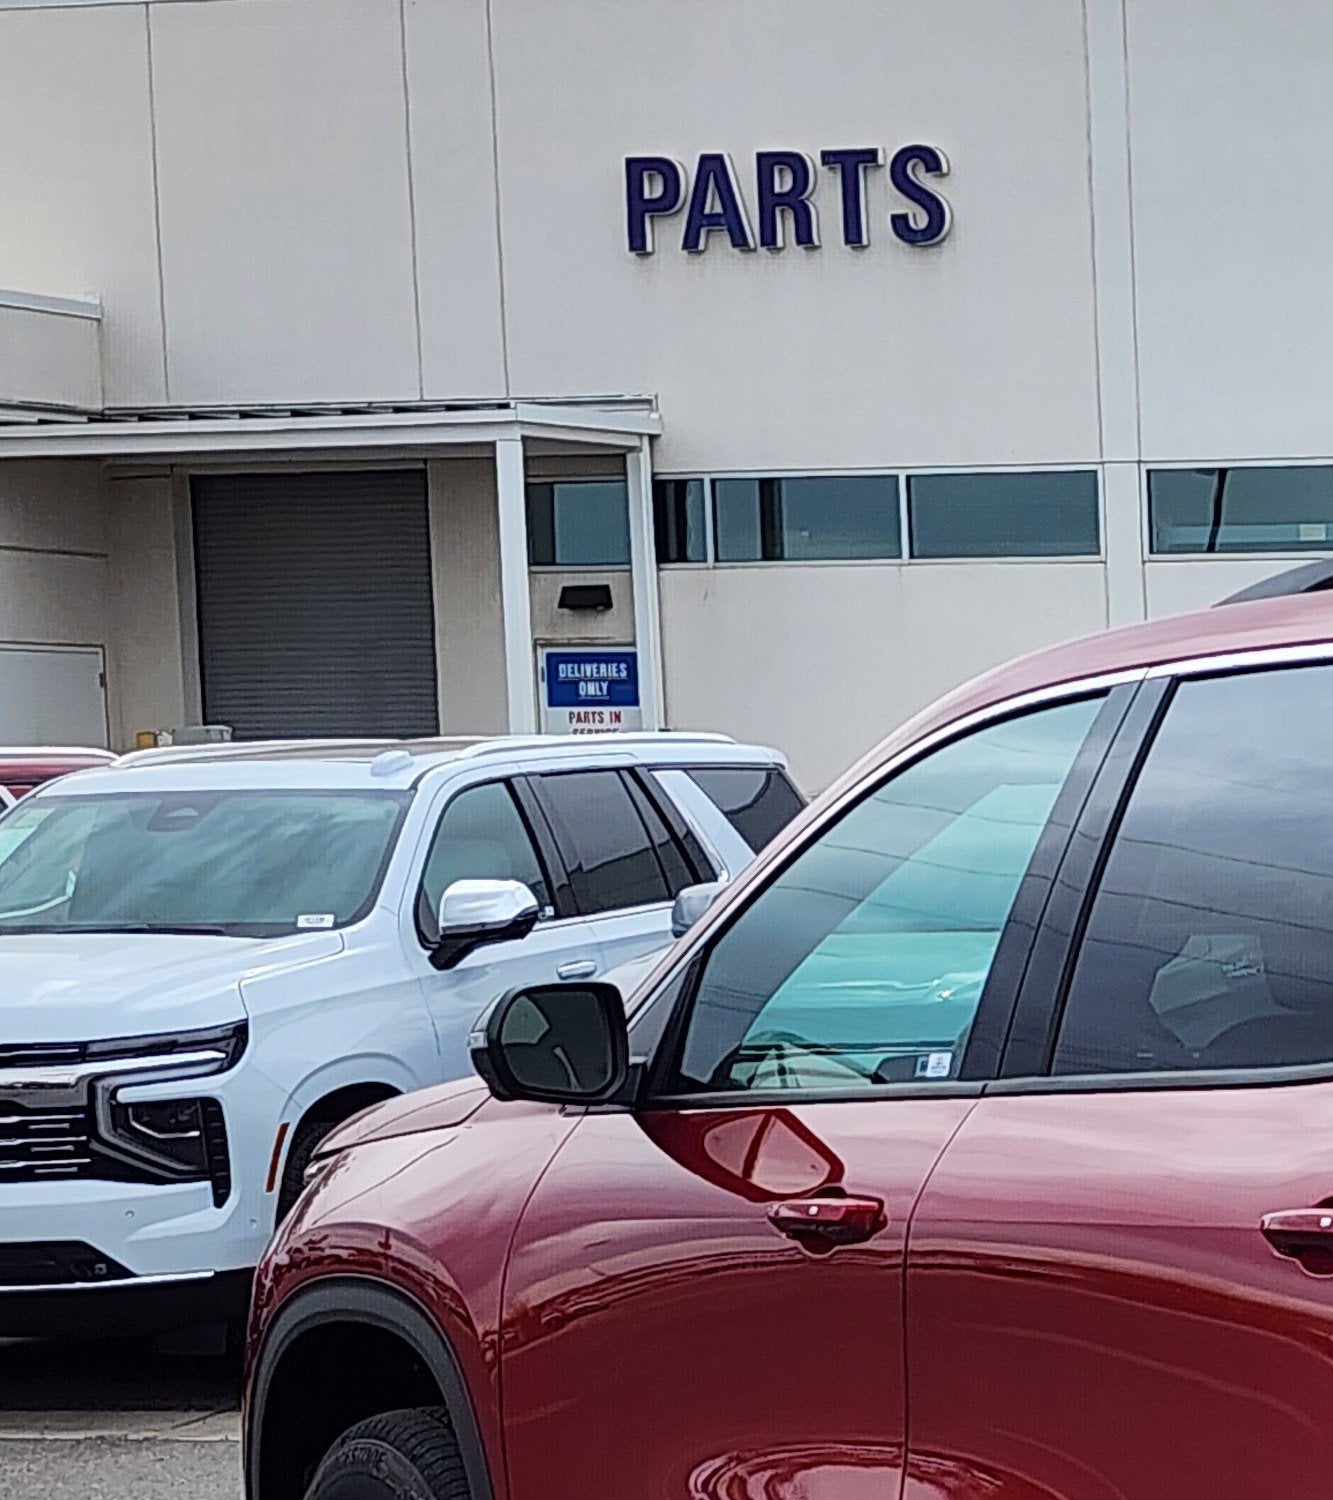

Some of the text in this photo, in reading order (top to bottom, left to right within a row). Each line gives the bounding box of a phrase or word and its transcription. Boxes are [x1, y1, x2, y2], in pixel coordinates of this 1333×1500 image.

[625, 144, 951, 253] PARTS
[558, 663, 627, 677] DELIVERIES
[578, 681, 608, 695] ONLY
[569, 711, 621, 724] PARTS IN
